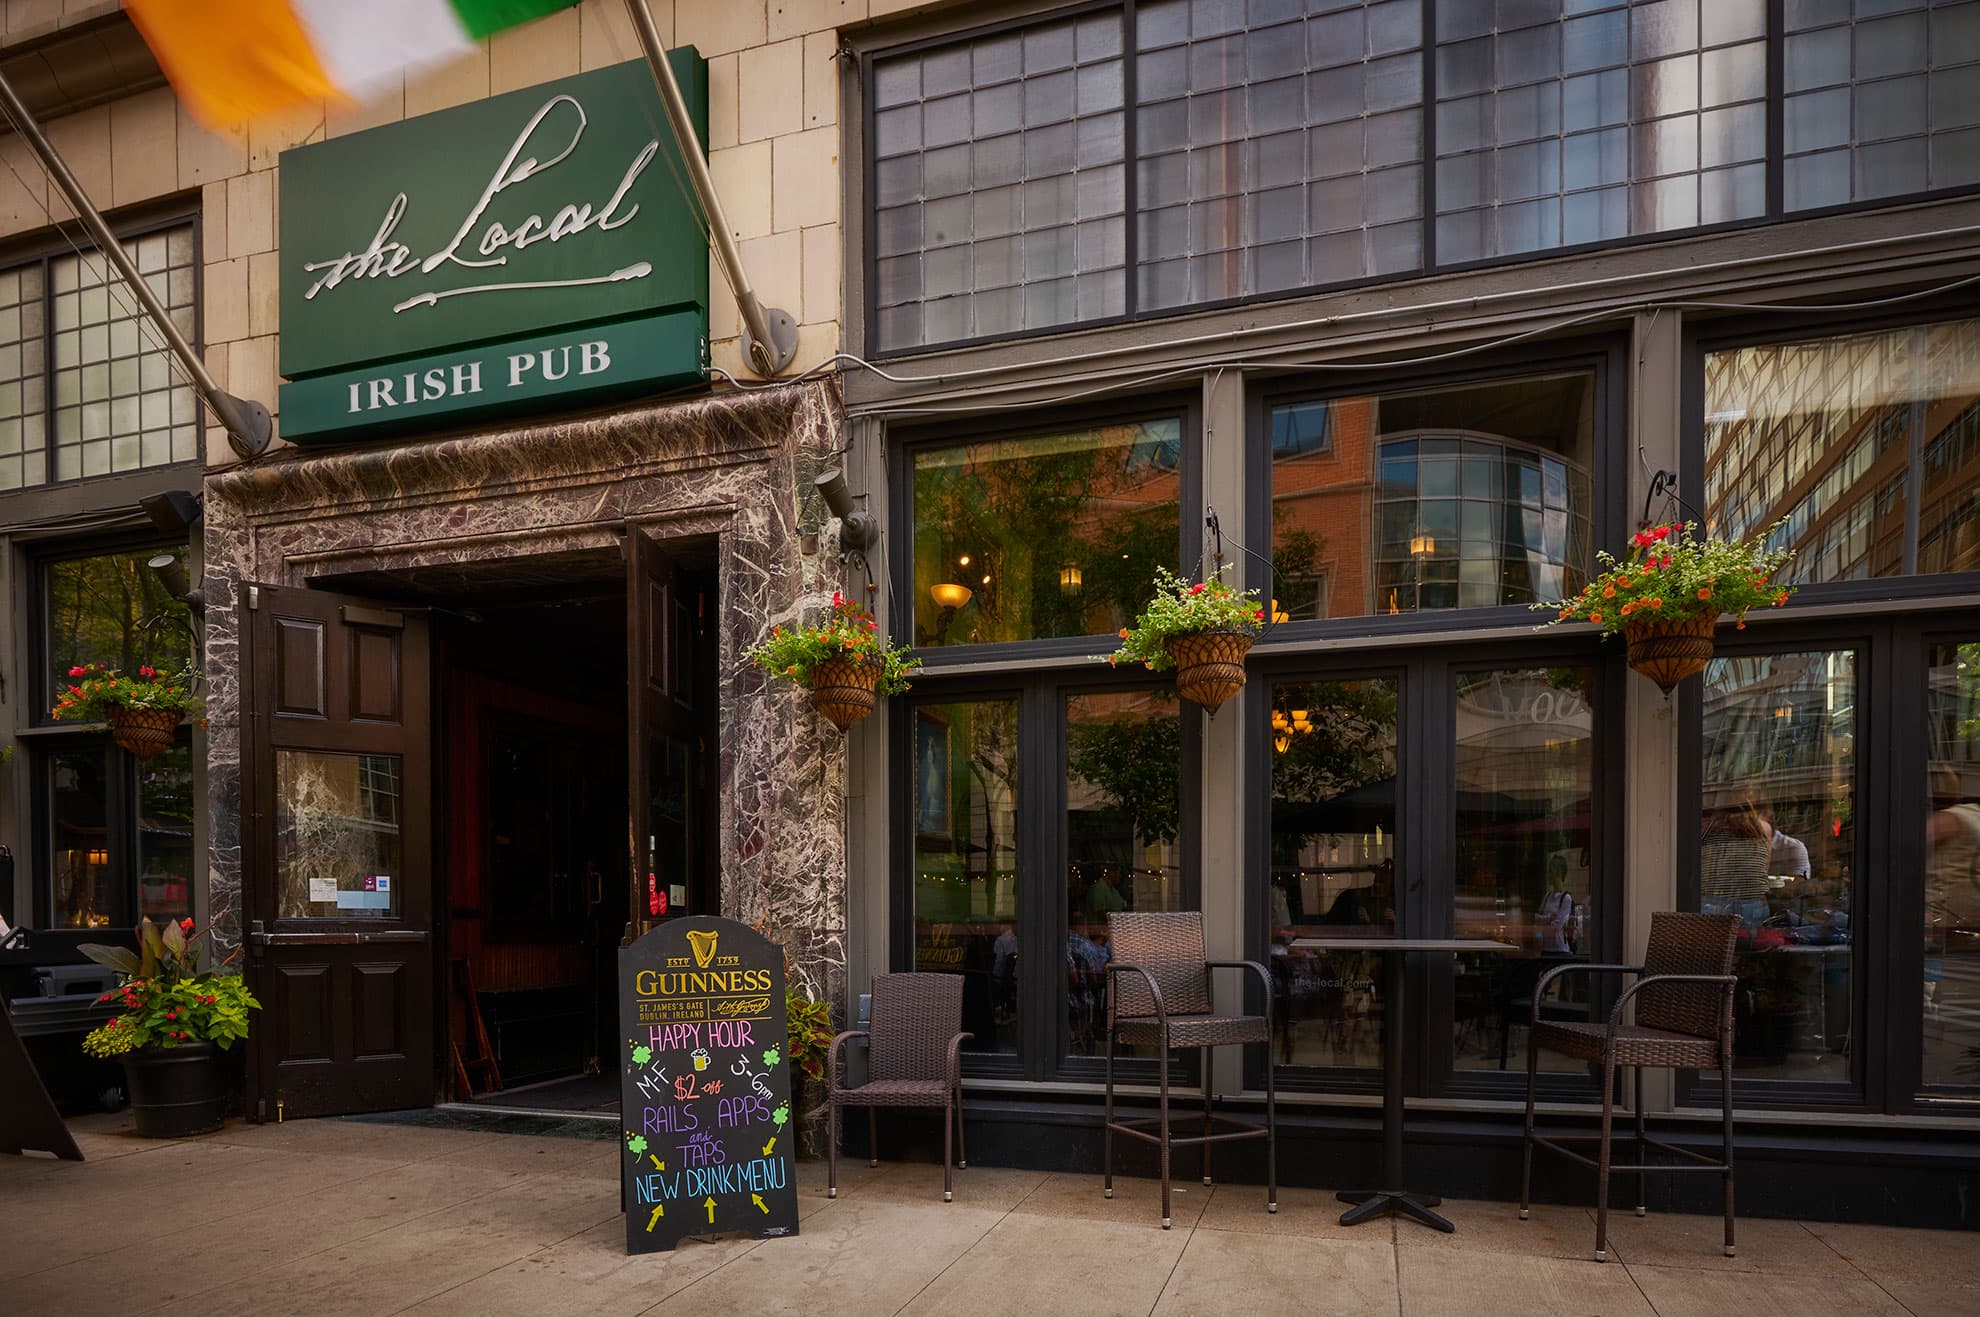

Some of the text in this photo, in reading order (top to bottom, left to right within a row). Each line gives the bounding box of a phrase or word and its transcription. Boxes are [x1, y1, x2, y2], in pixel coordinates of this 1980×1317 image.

[304, 94, 659, 299] the Local
[348, 340, 611, 413] IRISH PUB
[636, 969, 772, 995] GUINNESS
[639, 1004, 650, 1012] ST.
[653, 1002, 684, 1011] JAMES'S
[686, 1001, 704, 1010] GATE
[672, 1010, 704, 1020] IRELAND
[650, 1020, 755, 1052] HAPPY HOUR
[636, 1060, 670, 1099] M-F
[674, 1073, 725, 1101] $2 off
[643, 1095, 771, 1135] RAILS APPS
[689, 1126, 713, 1143] and
[675, 1140, 726, 1168] TAPS
[636, 1156, 785, 1204] NEW DRINK MENU
